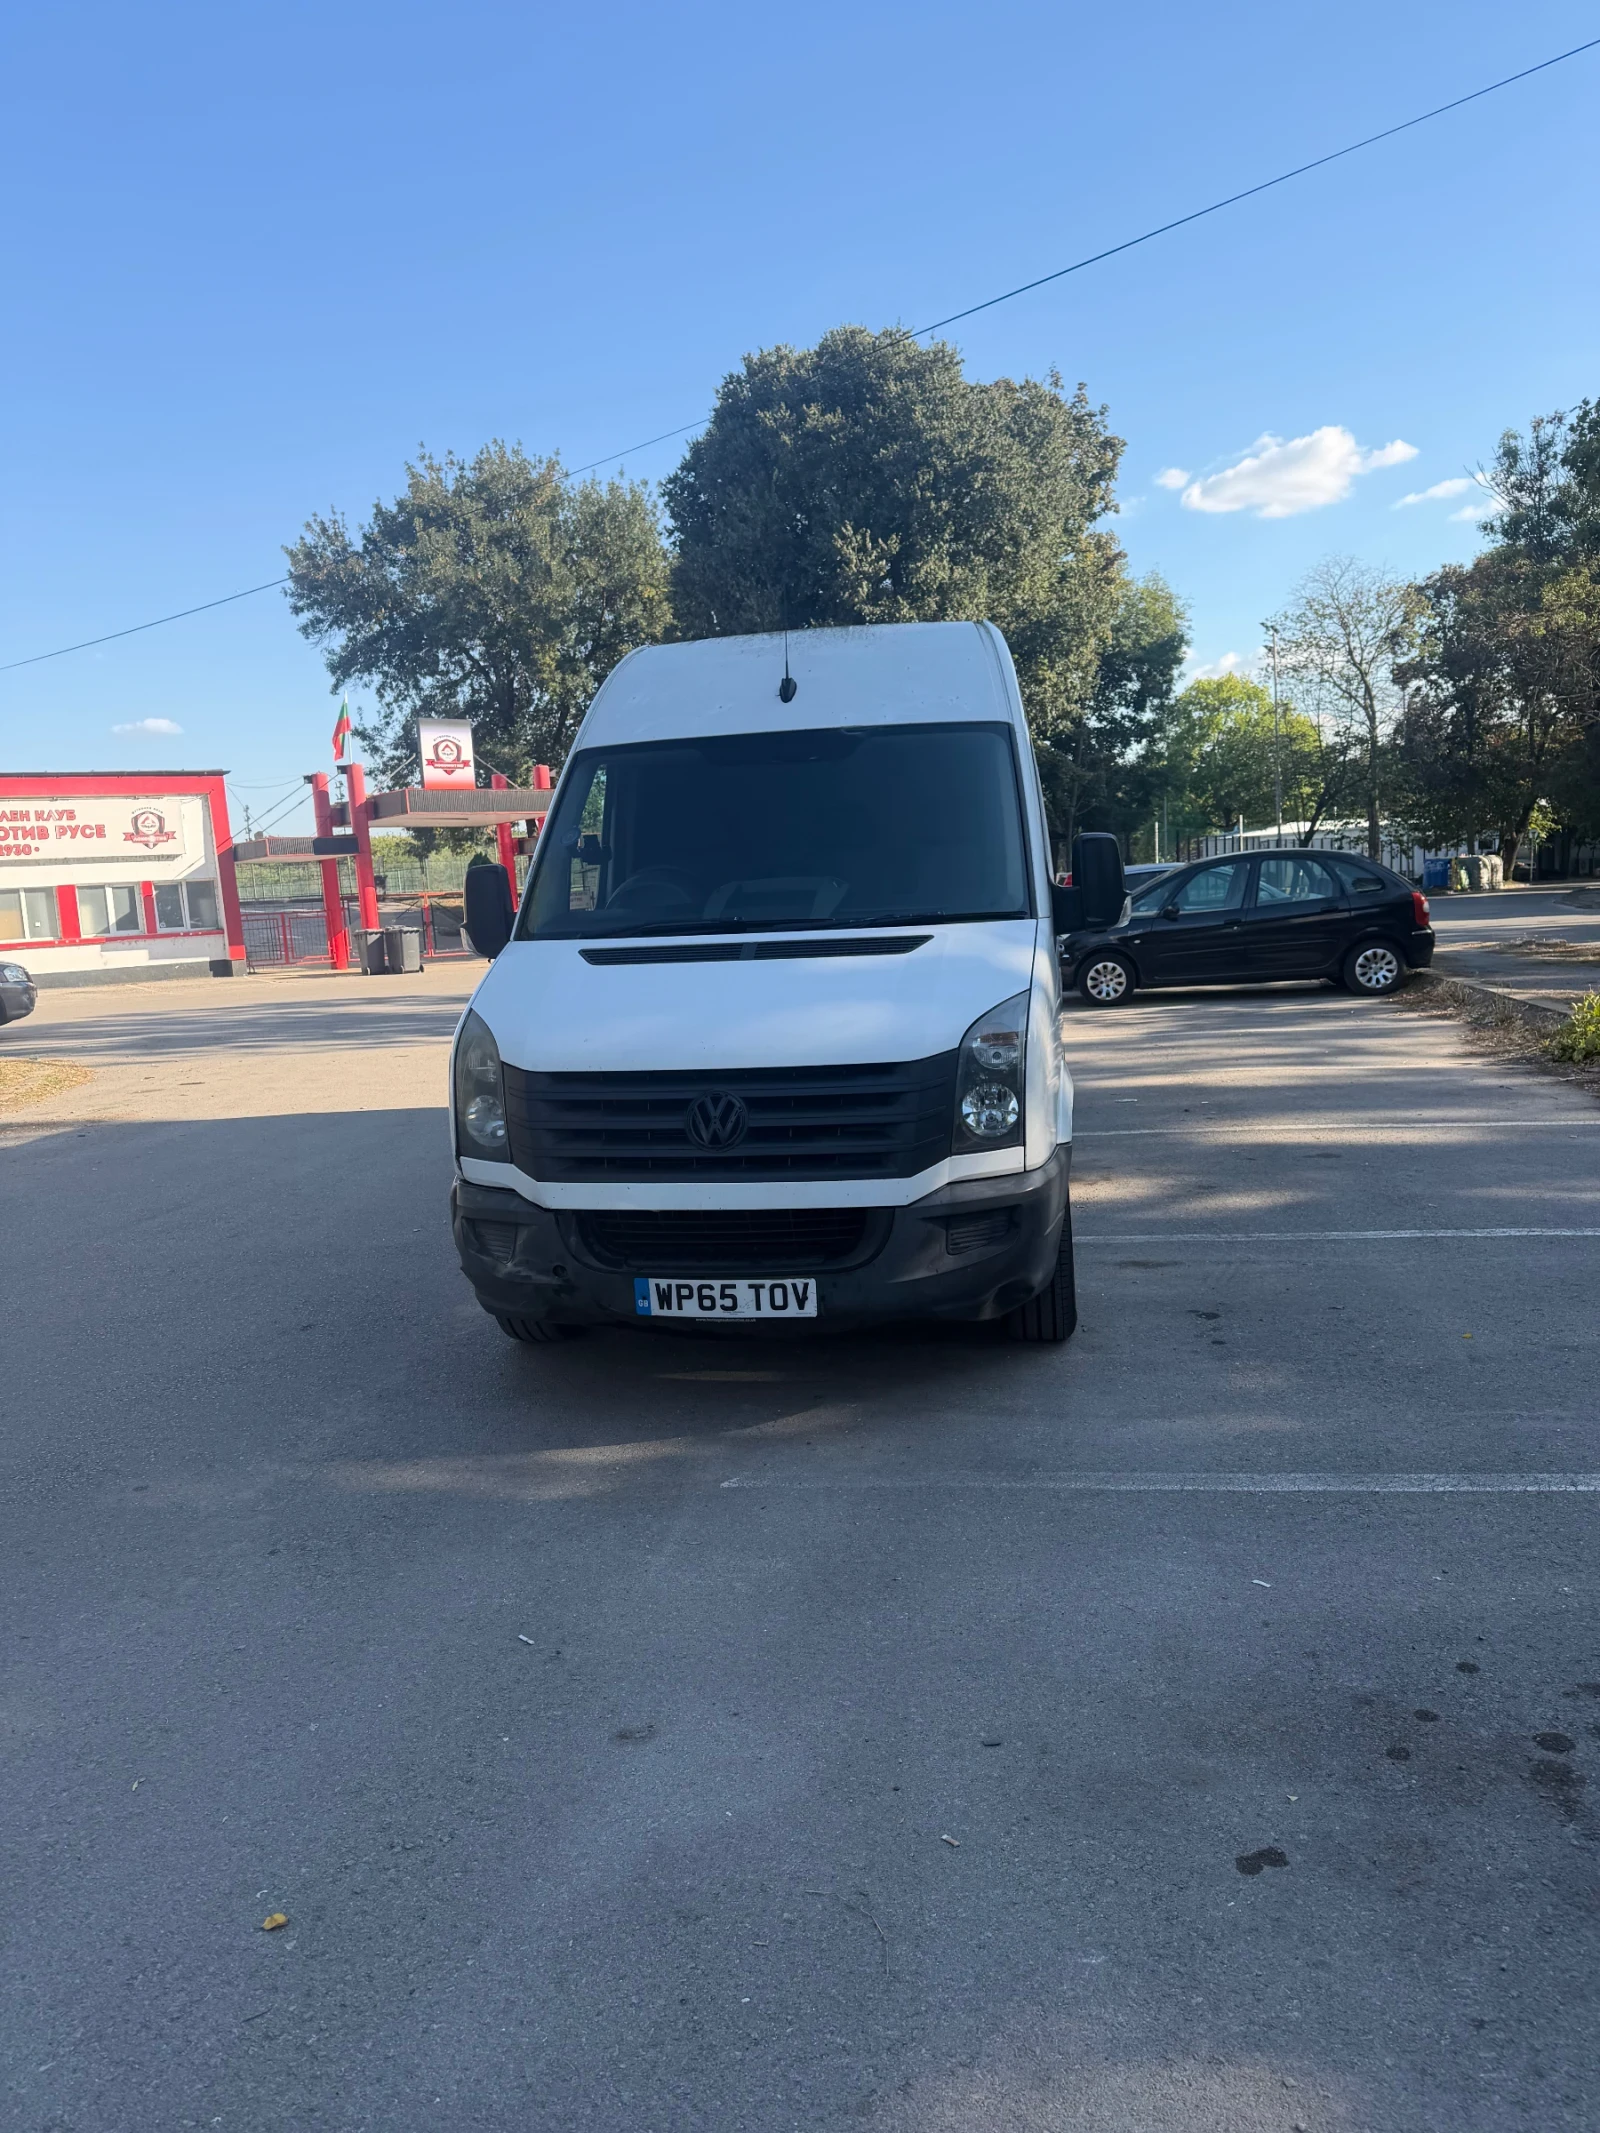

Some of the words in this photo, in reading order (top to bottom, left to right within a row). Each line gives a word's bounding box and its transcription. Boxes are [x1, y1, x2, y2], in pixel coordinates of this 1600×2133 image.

[34, 808, 77, 822] КЛУБ
[55, 824, 107, 839] РУСЕ
[638, 1299, 649, 1307] GB
[655, 1283, 738, 1311] WP65
[748, 1282, 810, 1311] TOV
